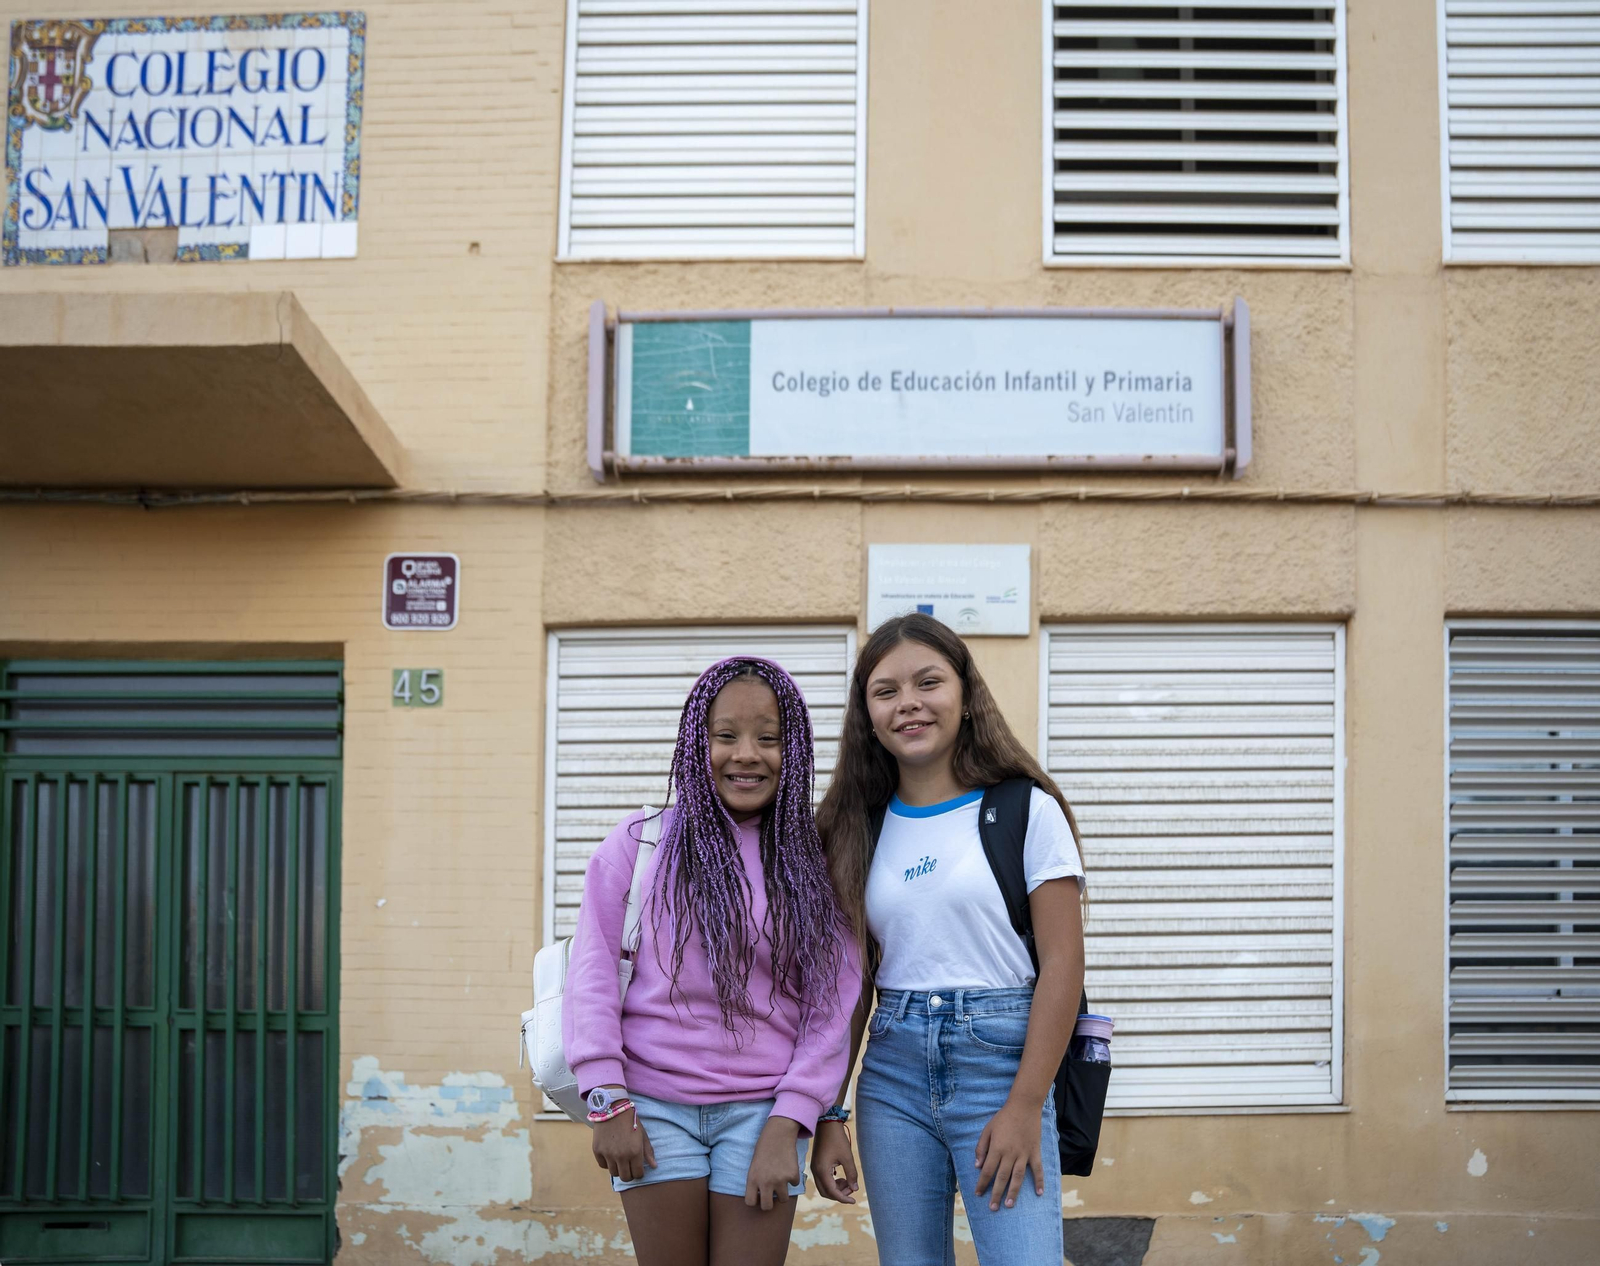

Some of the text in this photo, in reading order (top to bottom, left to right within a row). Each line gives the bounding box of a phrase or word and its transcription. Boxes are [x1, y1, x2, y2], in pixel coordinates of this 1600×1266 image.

[105, 47, 327, 97] COLEGIO
[81, 105, 329, 151] NACIONAL
[22, 164, 341, 230] SAN VALENTIN
[771, 370, 1193, 397] Colegio de Educación Infantil y Primaria
[1067, 401, 1194, 424] San Valentín
[393, 669, 440, 704] 45
[904, 856, 937, 882] nike
